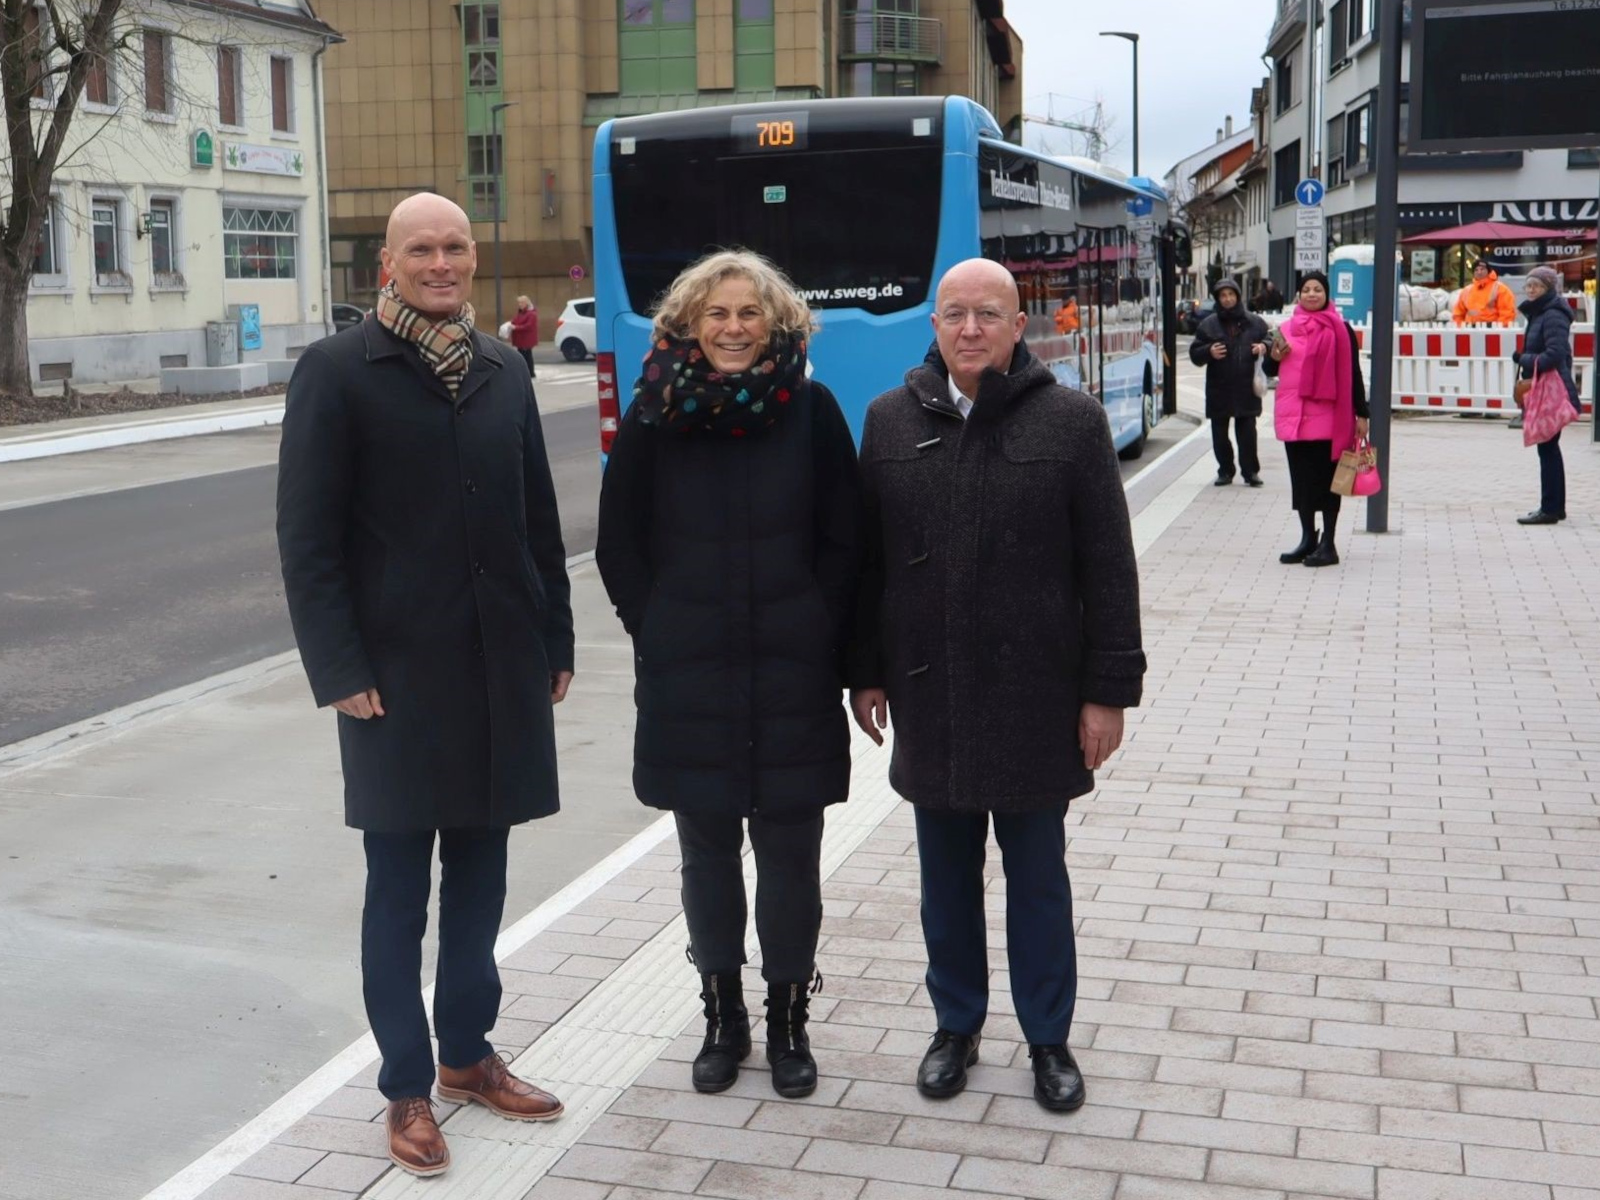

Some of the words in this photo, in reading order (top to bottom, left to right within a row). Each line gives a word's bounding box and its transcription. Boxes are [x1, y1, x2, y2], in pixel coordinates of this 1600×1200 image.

[1460, 73, 1482, 82] Bitte
[756, 121, 794, 147] 709
[1494, 246, 1540, 257] GUTEM
[1298, 253, 1319, 261] TAXI
